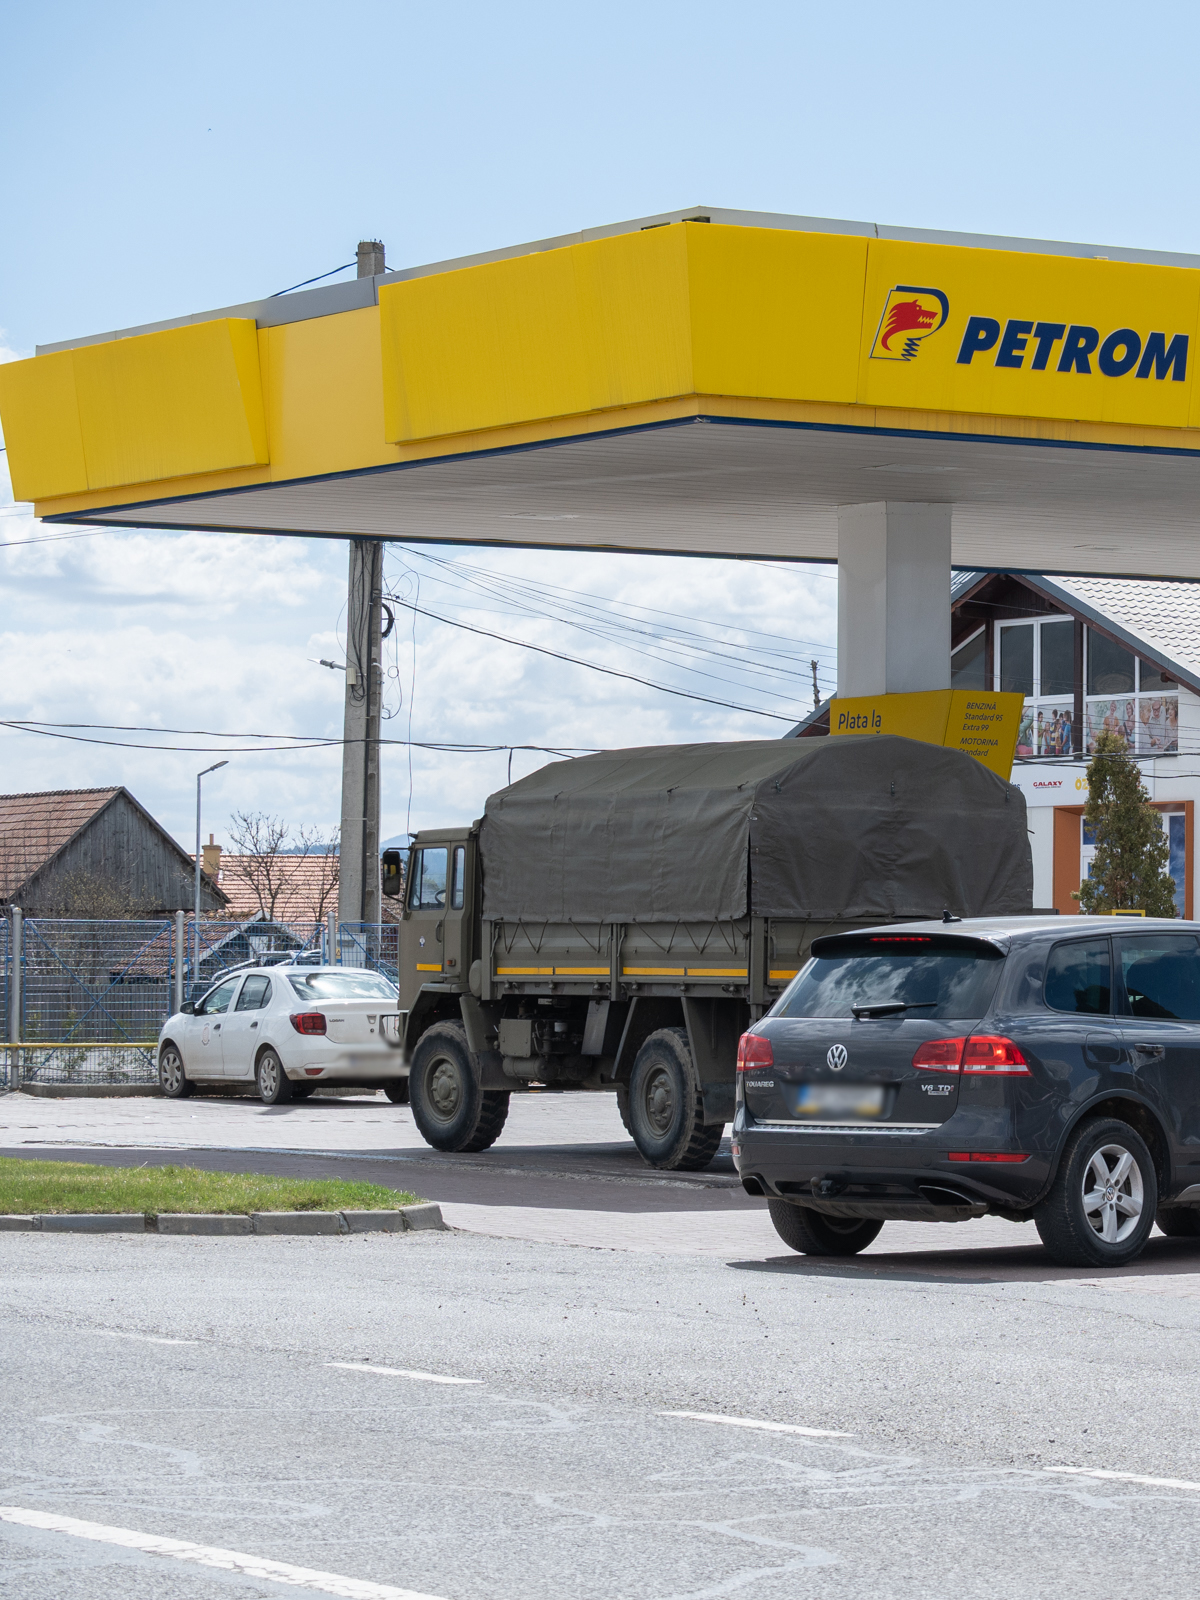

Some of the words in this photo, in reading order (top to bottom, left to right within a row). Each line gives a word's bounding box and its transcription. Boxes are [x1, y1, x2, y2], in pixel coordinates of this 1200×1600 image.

[956, 315, 1189, 382] PETROM
[838, 711, 868, 729] Plata
[871, 709, 882, 728] la
[964, 713, 995, 721] Standard
[962, 723, 980, 731] Extra
